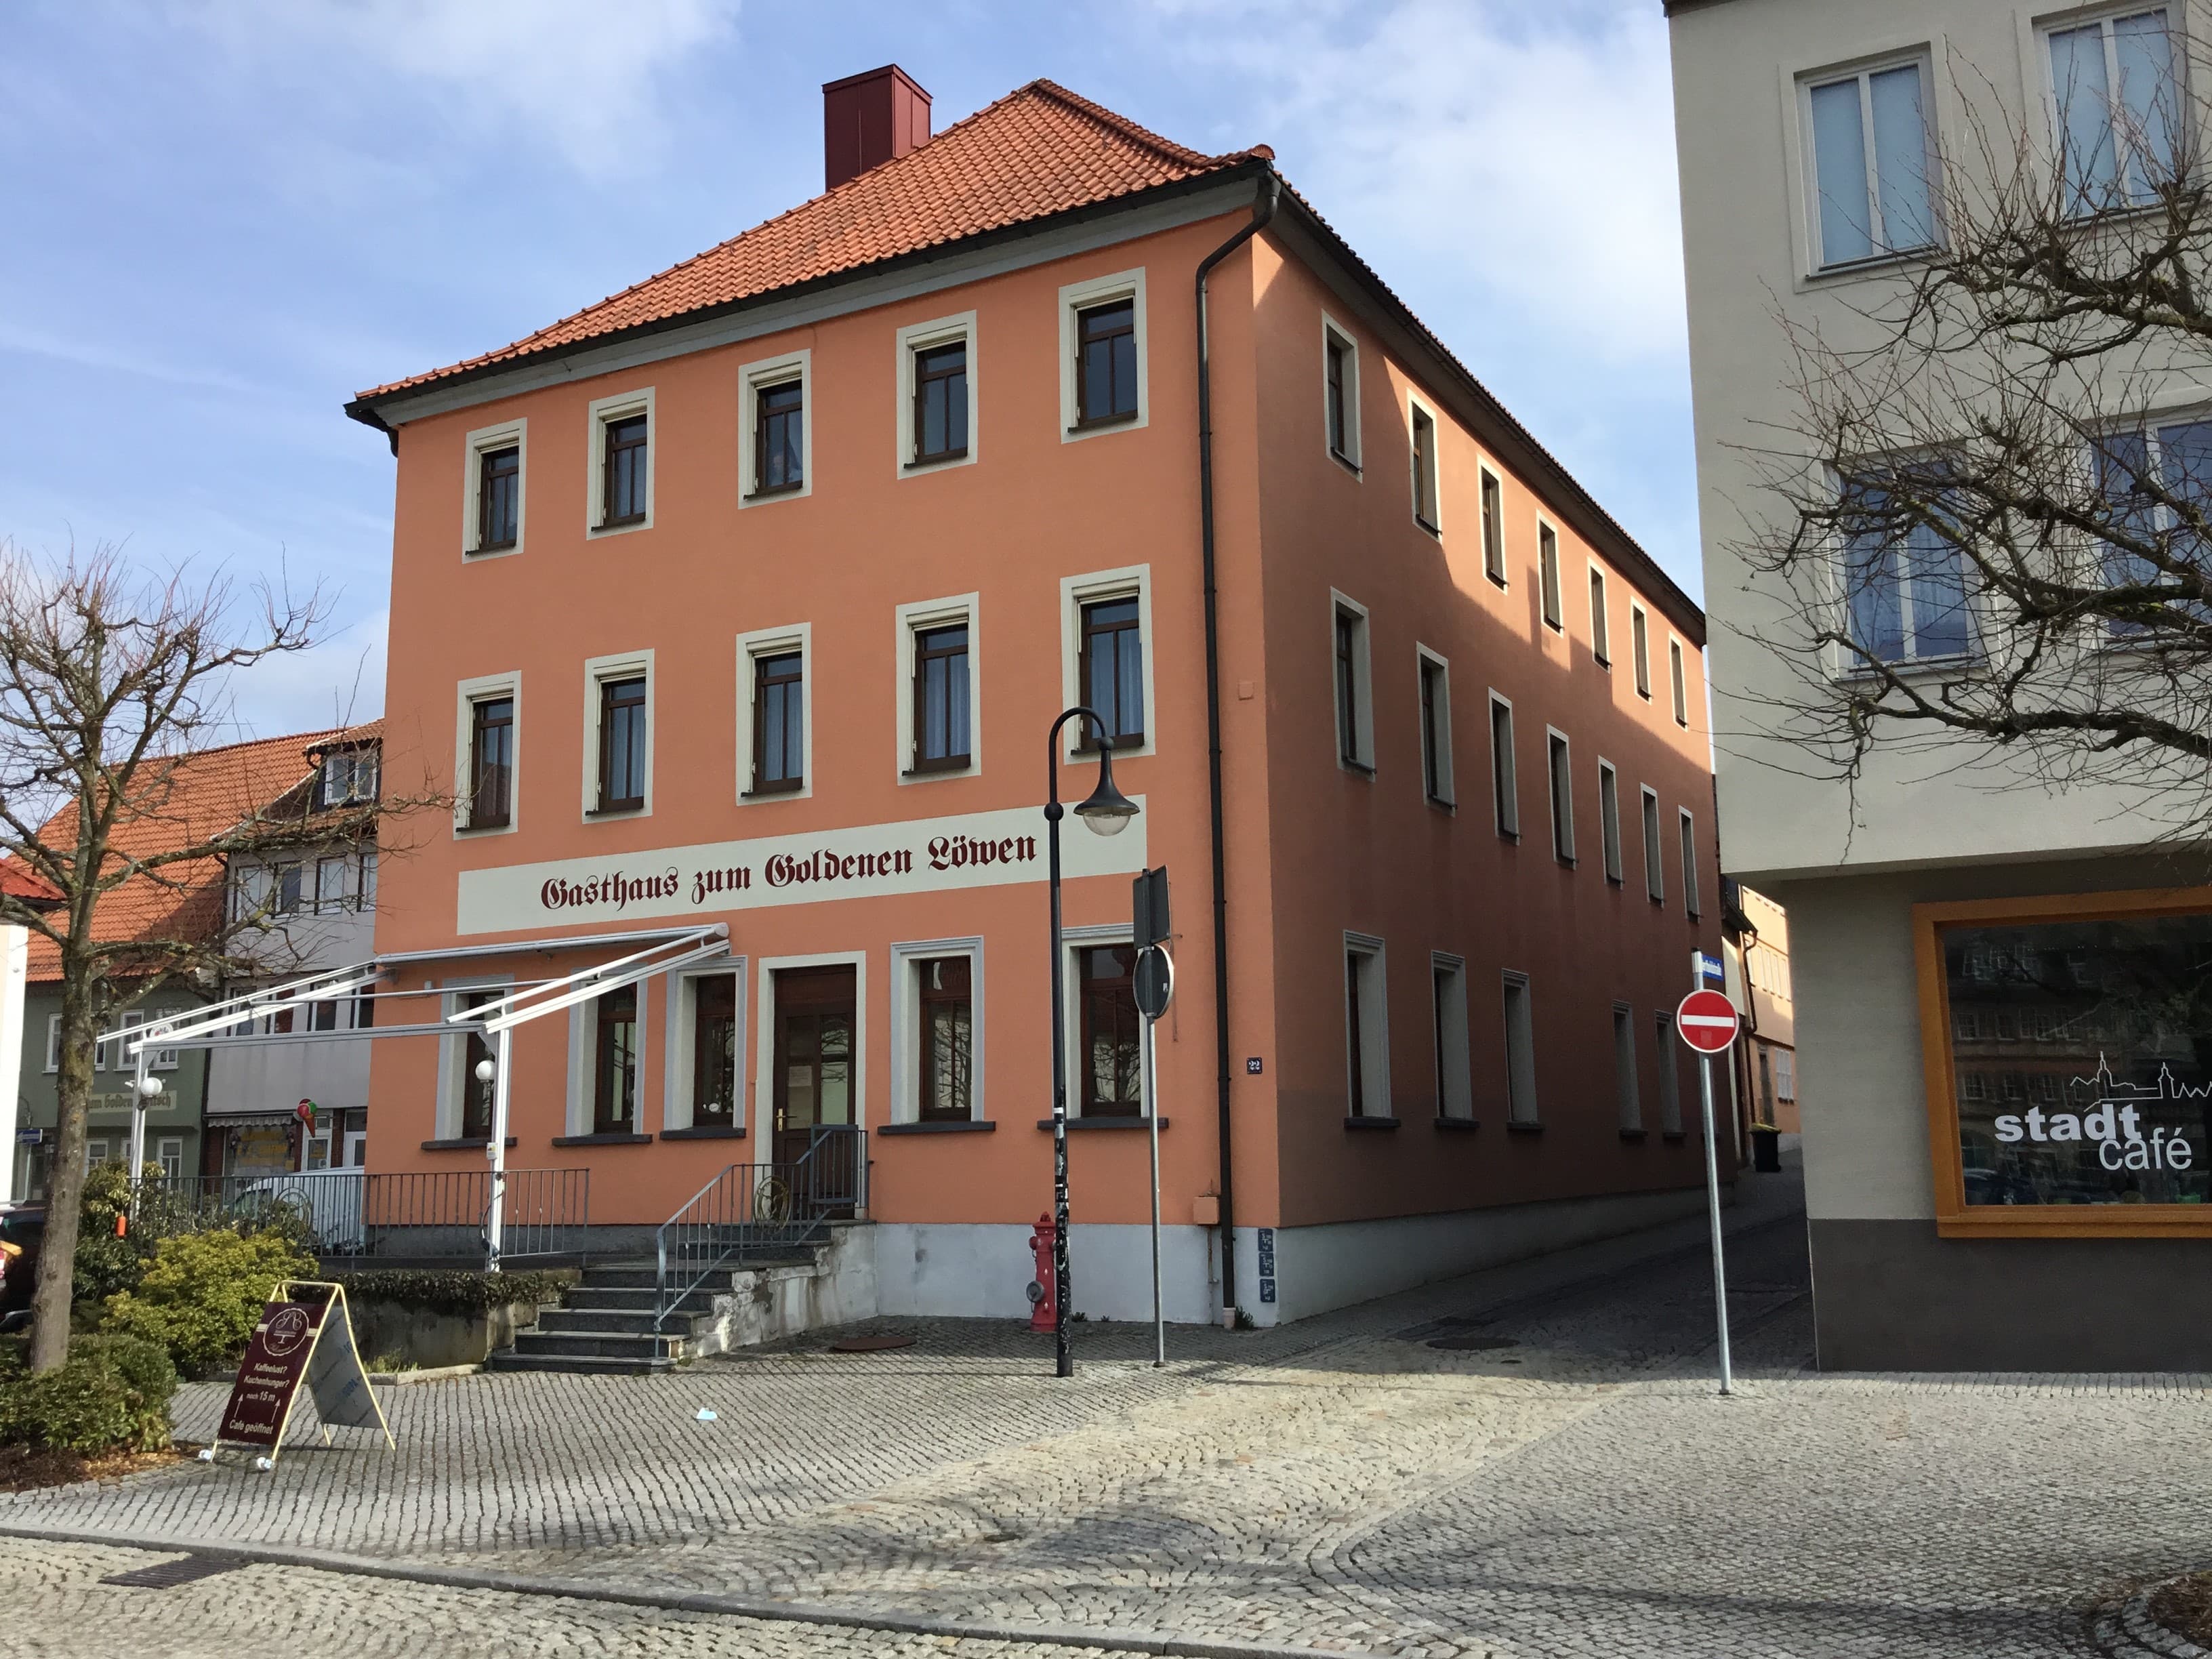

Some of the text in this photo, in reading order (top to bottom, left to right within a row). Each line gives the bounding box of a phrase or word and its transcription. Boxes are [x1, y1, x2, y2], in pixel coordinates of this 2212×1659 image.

[541, 835, 1037, 912] Gasthaus zum Goldenen Löwen
[1994, 1103, 2142, 1142] stadt
[2099, 1127, 2192, 1170] café
[253, 1362, 288, 1374] Kaffeelust?
[243, 1375, 290, 1389] Kuchenhunger?
[260, 1390, 269, 1401] 15
[268, 1393, 276, 1401] m
[244, 1422, 274, 1435] geöffnet
